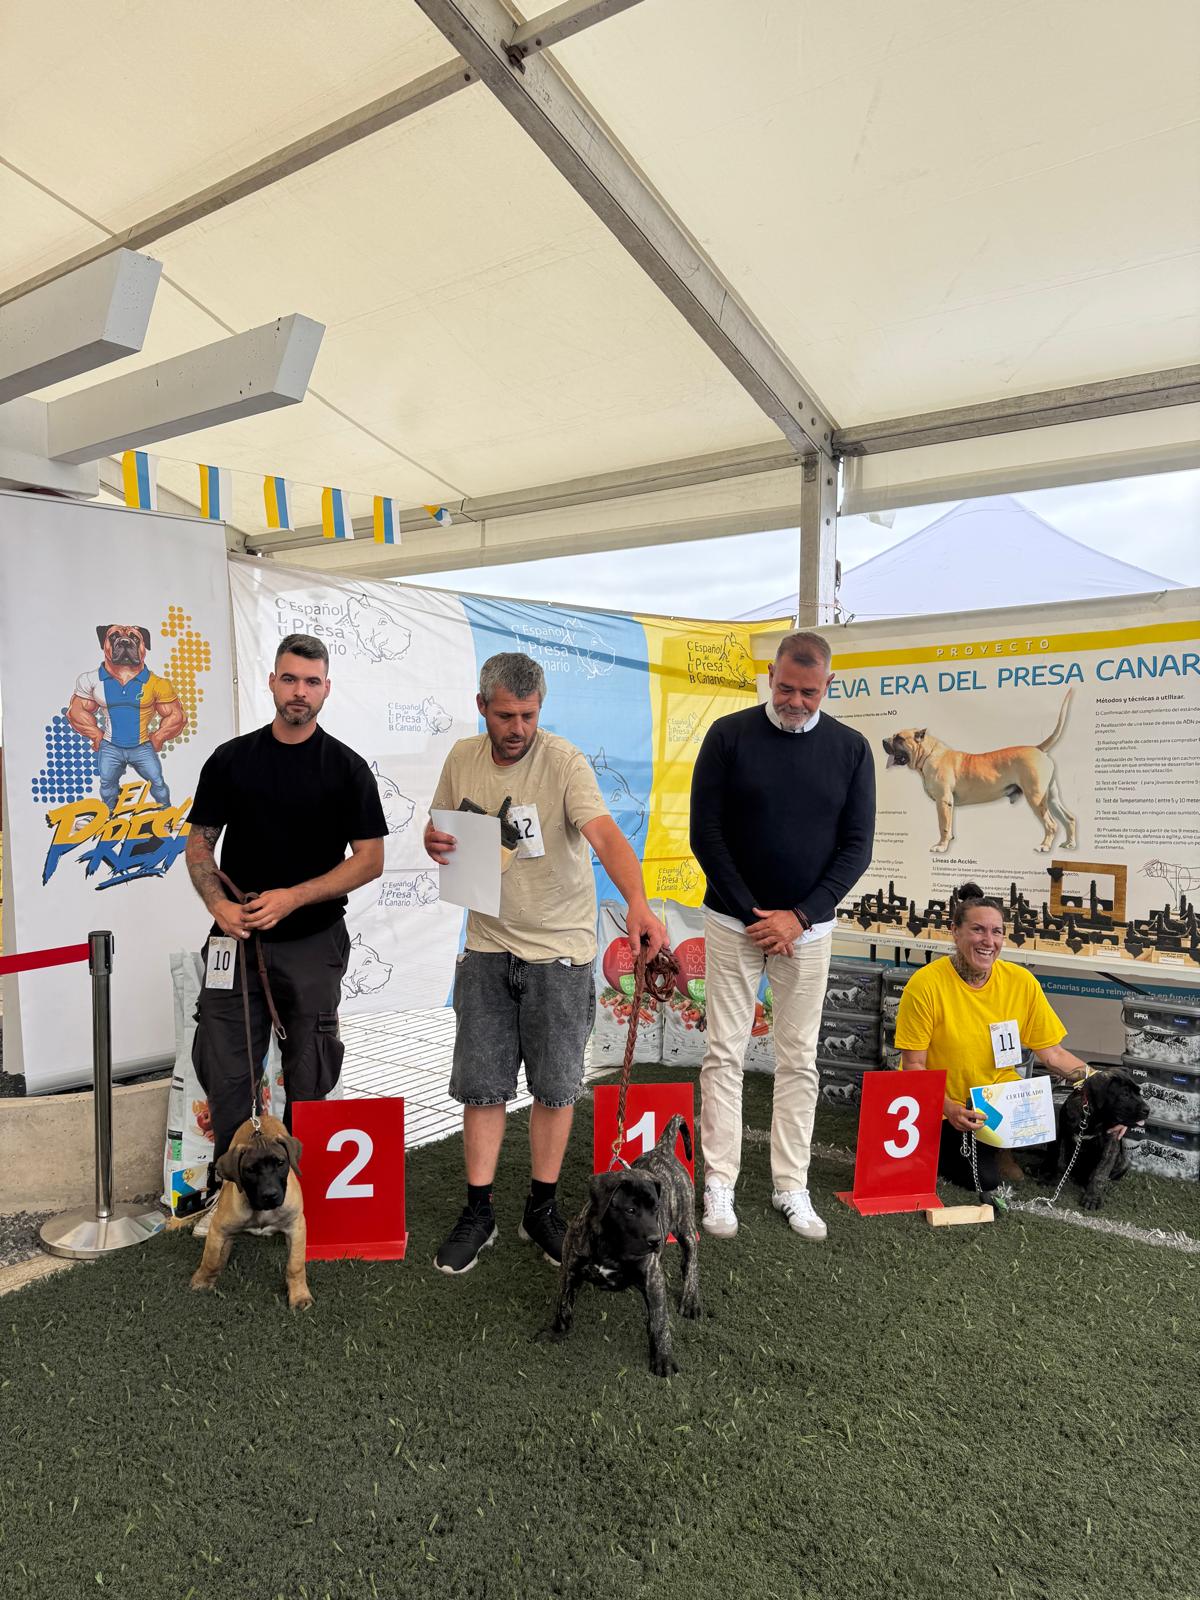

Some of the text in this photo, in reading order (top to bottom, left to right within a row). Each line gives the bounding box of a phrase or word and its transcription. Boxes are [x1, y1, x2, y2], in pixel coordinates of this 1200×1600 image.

[289, 601, 344, 616] Español
[292, 618, 345, 639] Presa
[522, 624, 565, 637] Español
[528, 640, 569, 657] Presa
[694, 641, 722, 655] Español
[936, 639, 1049, 657] PROYECTO
[695, 657, 723, 672] Presa
[696, 672, 726, 685] Canario
[828, 677, 870, 699] EVA
[880, 674, 929, 696] ERA
[938, 670, 987, 692] DEL
[997, 662, 1084, 688] PRESA
[395, 702, 421, 711] Español
[395, 712, 421, 723] Presa
[395, 722, 421, 731] Canario
[112, 780, 165, 817] EL
[388, 881, 414, 889] Español
[386, 889, 412, 899] Presa
[384, 898, 411, 907] Canario
[213, 950, 231, 971] 10
[1046, 981, 1080, 992] Canarias
[1080, 985, 1105, 997] pueda
[999, 1032, 1016, 1052] 11
[626, 1111, 656, 1154] 1
[883, 1095, 920, 1159] 3
[325, 1128, 374, 1199] 2
